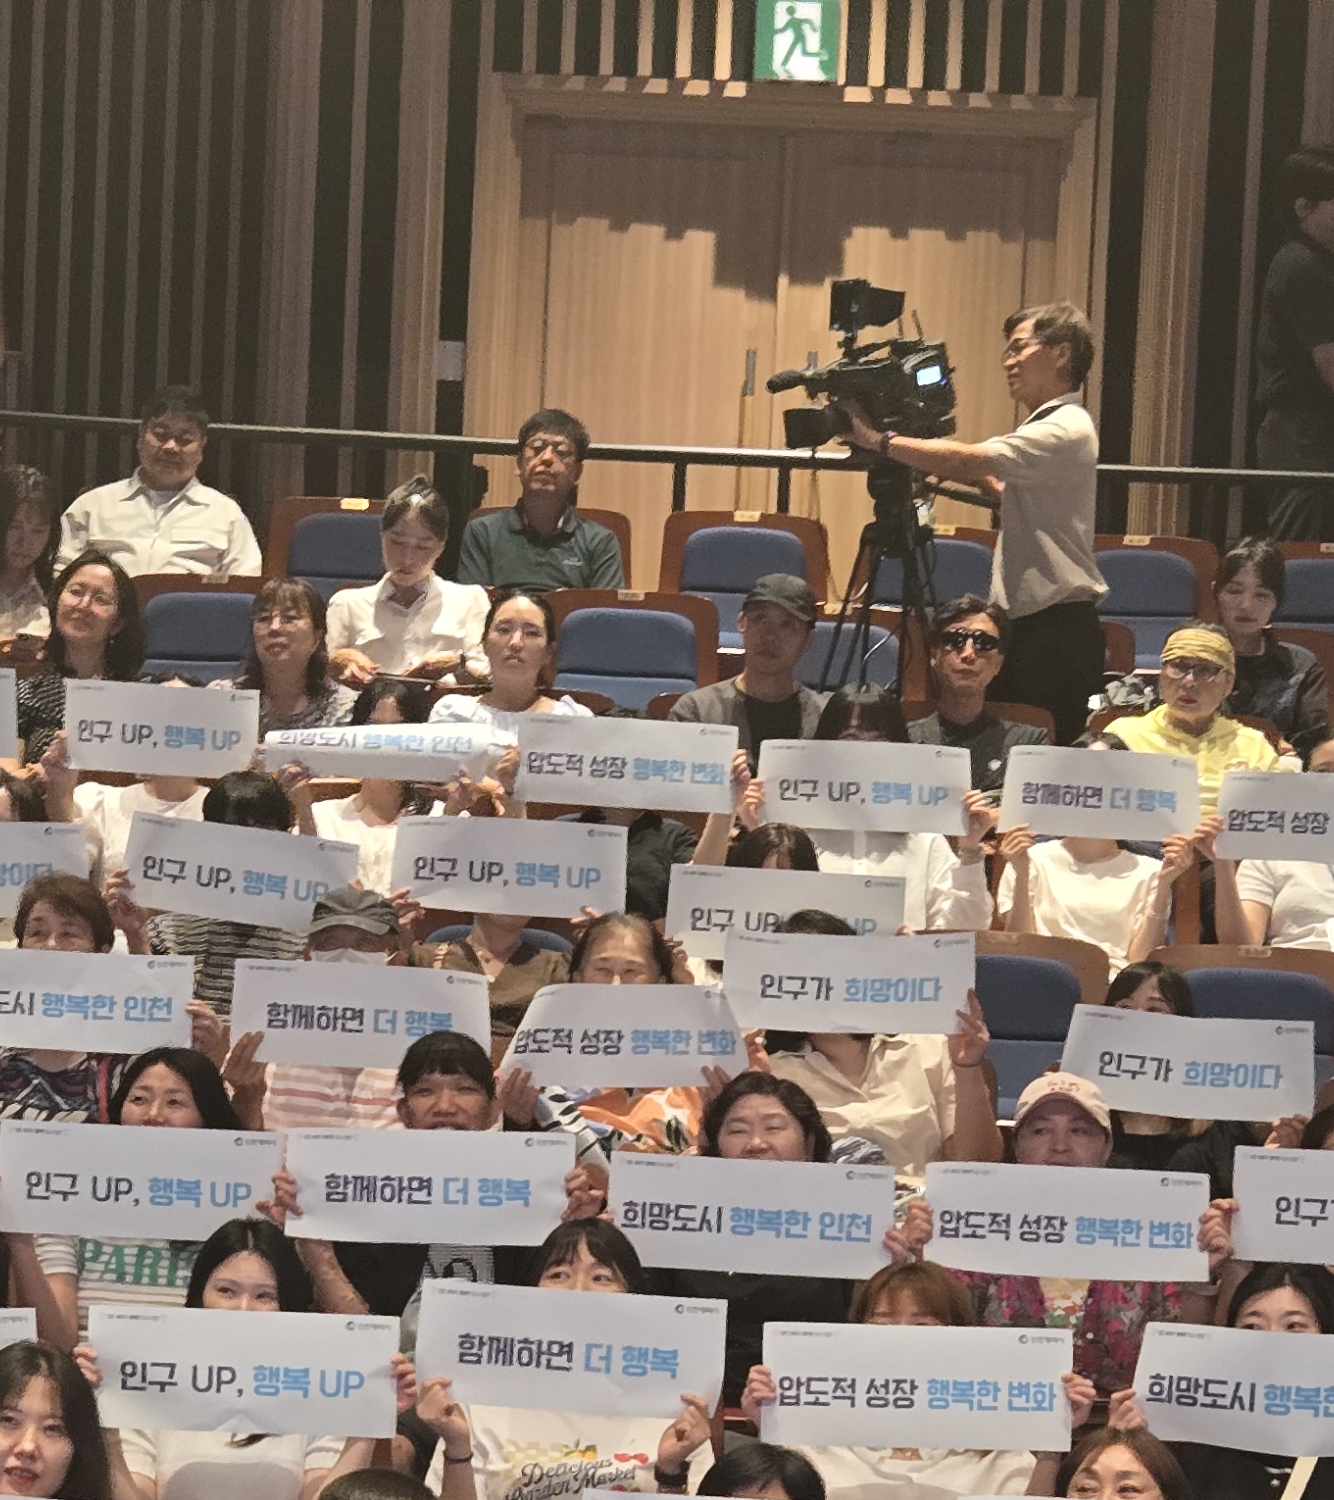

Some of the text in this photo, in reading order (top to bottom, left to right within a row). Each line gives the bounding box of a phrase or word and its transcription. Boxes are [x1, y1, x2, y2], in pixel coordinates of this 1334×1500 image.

[77, 719, 241, 751] 인구 UP, 행복 UP
[1227, 808, 1286, 833] 압도적
[41, 992, 117, 1020] 행복한
[123, 996, 172, 1022] 인천
[759, 973, 942, 1003] 인구가 희망이다
[1098, 1050, 1283, 1089] 인구가 희망이다
[25, 1170, 252, 1208] 인구 UP, 행복 UP
[620, 1200, 871, 1242] 희망도시 행복한 인천
[939, 1209, 1193, 1248] 압도적 성장 행복한 변화
[78, 1237, 197, 1288] PARI
[118, 1360, 364, 1398] 인구 UP, 행복 UP
[1145, 1372, 1256, 1413] 희망도시
